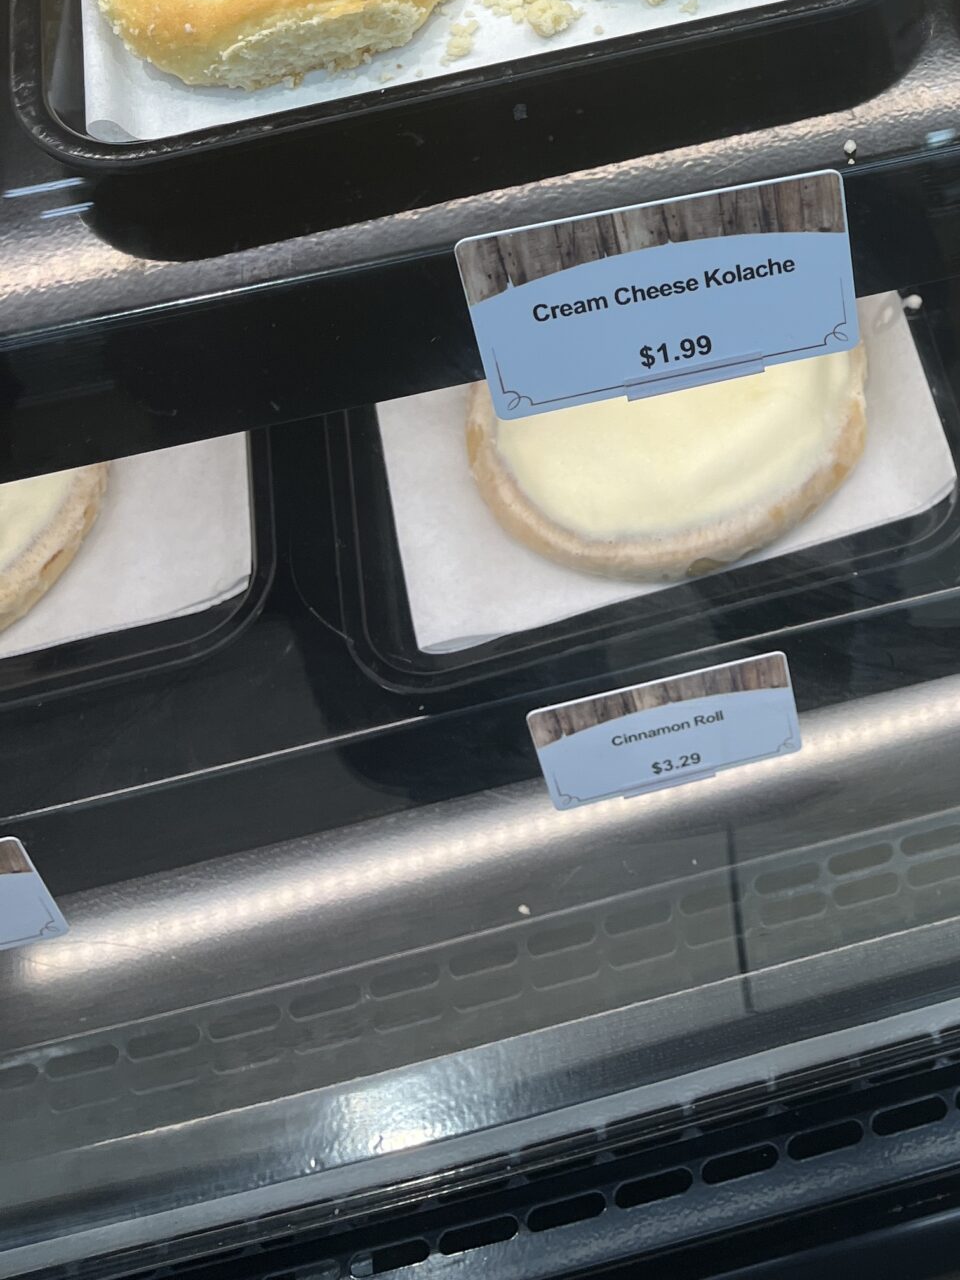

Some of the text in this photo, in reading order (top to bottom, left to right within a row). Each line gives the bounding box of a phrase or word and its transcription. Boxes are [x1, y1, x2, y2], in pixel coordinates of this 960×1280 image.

[532, 257, 796, 322] Cream Cheese Kolache
[639, 334, 713, 369] $1.99
[611, 710, 725, 747] Cinnamon Roll
[651, 752, 701, 775] $3.29
